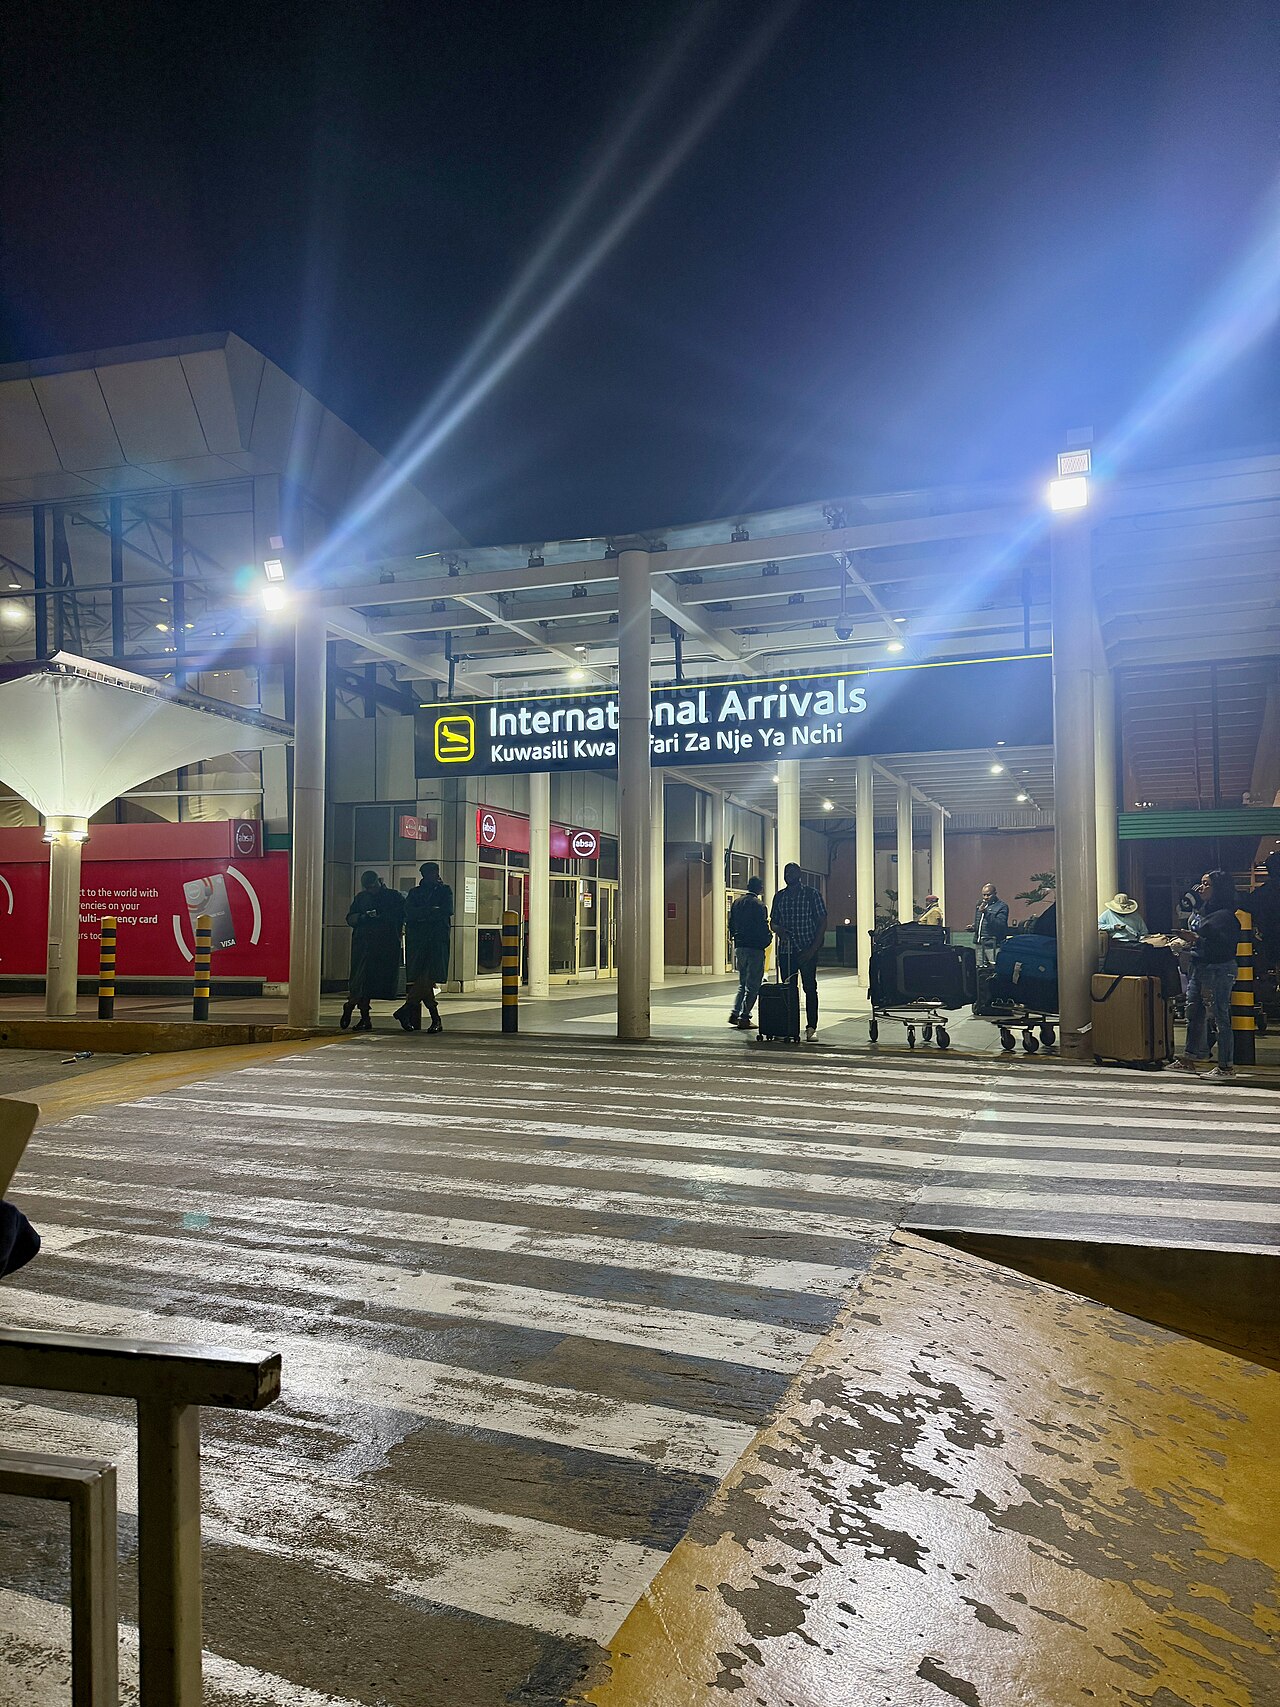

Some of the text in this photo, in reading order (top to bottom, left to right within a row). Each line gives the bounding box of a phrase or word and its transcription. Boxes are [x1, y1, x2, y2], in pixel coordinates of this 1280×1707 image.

[490, 680, 868, 737] Internatnal Arrivals
[491, 722, 843, 763] Kuwasili Kwa fari Za Nje Ya Nchi
[575, 838, 593, 848] absa
[86, 888, 97, 897] to
[98, 887, 112, 897] the
[113, 887, 138, 898] world
[139, 887, 159, 898] with
[108, 902, 119, 910] on
[120, 902, 140, 913] your
[138, 914, 158, 924] card
[220, 938, 236, 948] VISA
